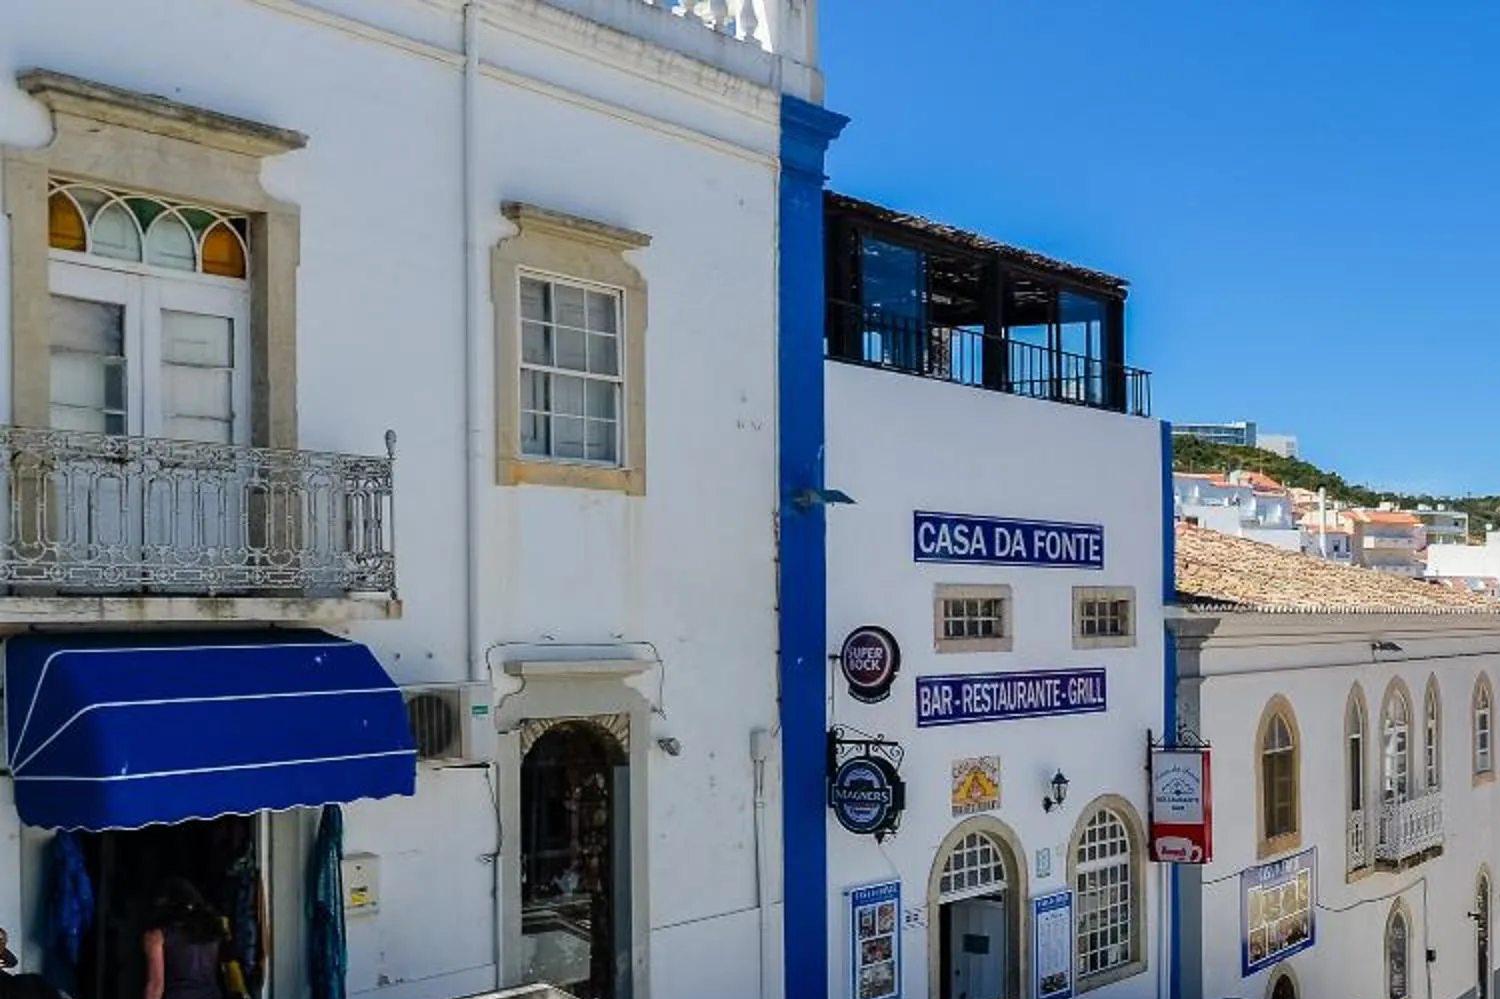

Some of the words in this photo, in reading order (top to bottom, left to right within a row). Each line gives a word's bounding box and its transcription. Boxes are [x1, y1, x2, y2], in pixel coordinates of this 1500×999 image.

[918, 521, 987, 556] CASA
[994, 527, 1027, 558] DA
[1033, 530, 1101, 561] FONTE
[847, 646, 883, 660] SUPER
[849, 659, 881, 671] BOCK
[835, 788, 889, 803] MAGNERS
